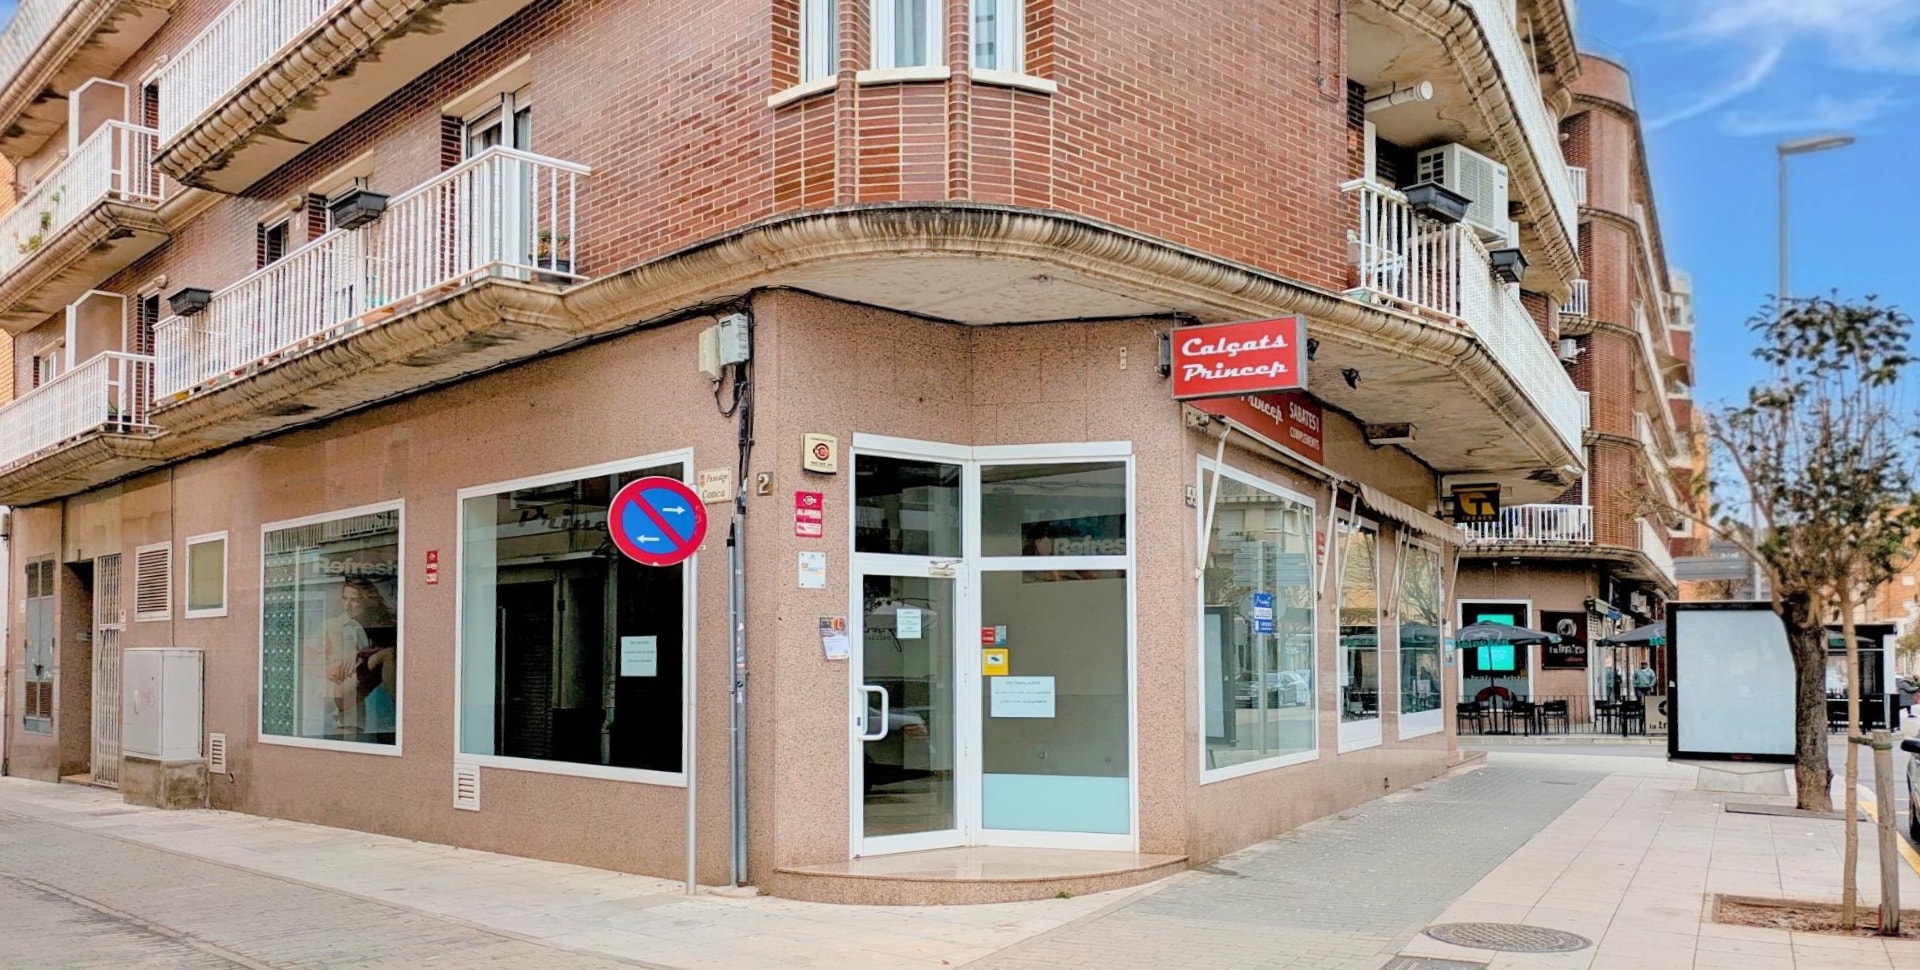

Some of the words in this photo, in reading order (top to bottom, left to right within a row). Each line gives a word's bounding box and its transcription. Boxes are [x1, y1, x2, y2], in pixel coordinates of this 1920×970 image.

[1181, 335, 1288, 357] Calçats
[1182, 361, 1289, 382] Princep
[758, 473, 769, 494] 2
